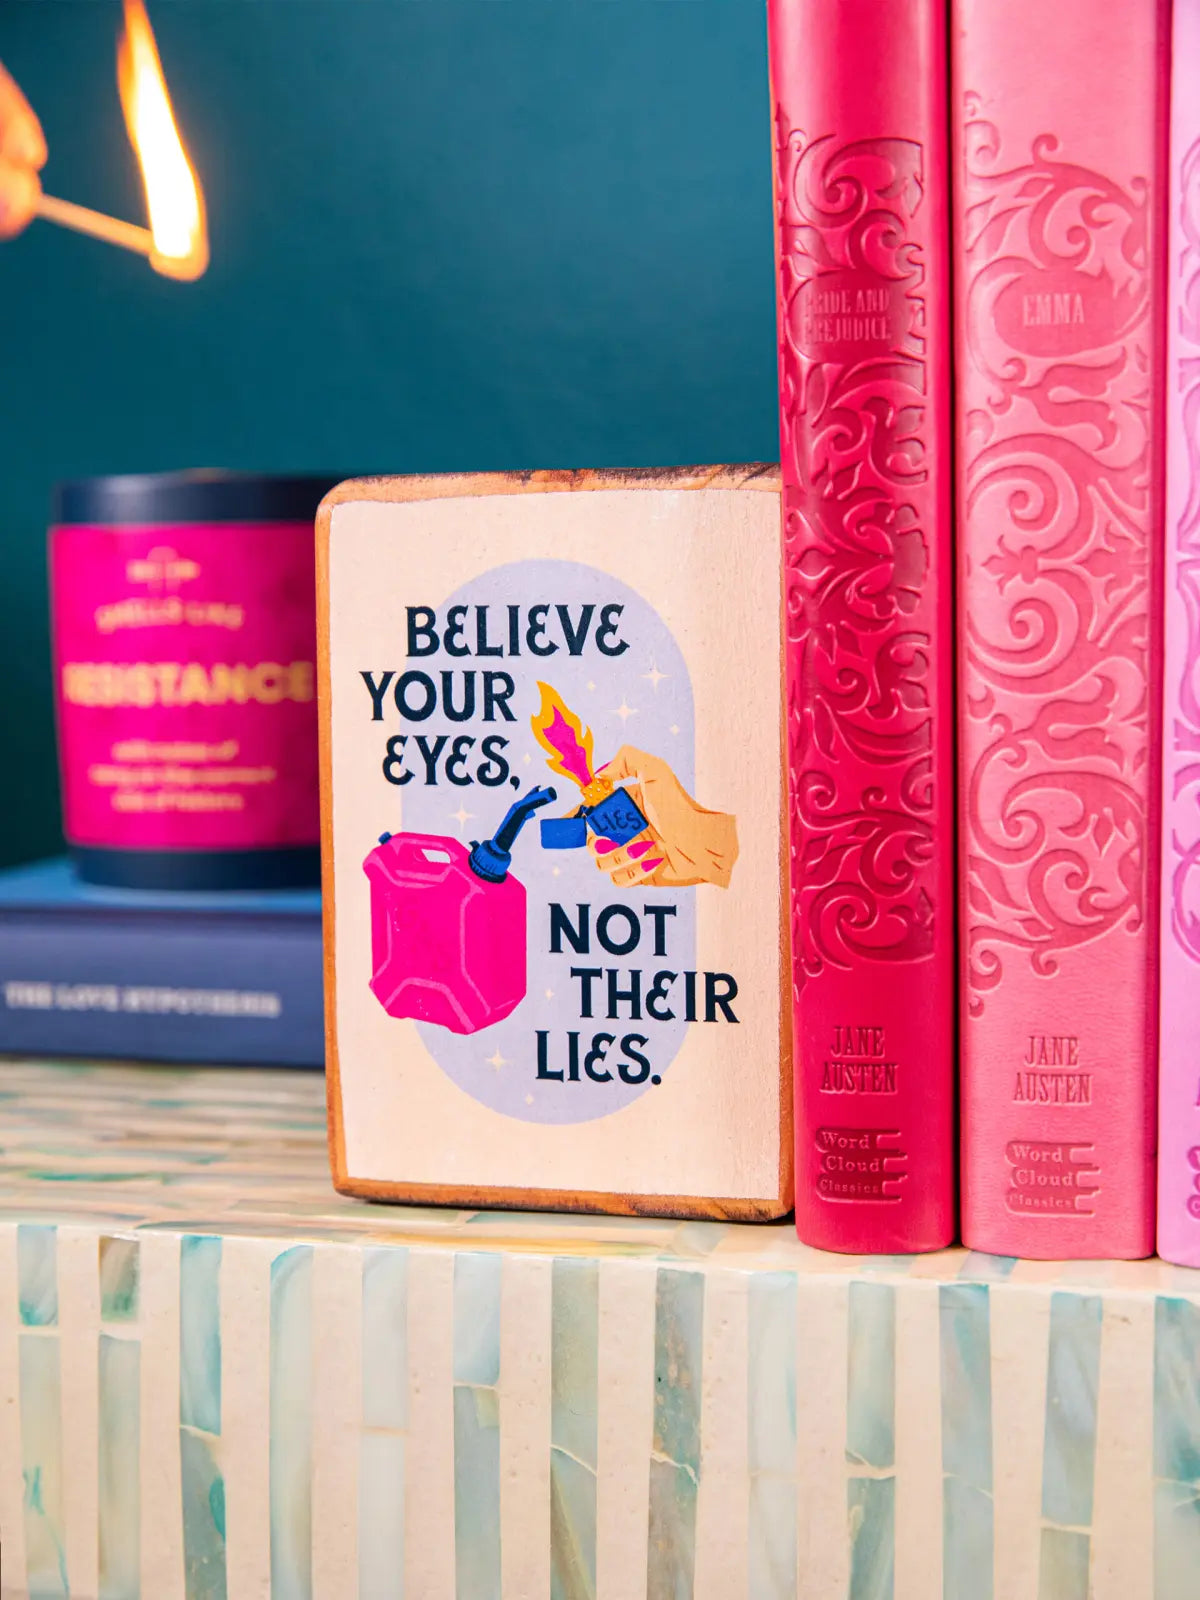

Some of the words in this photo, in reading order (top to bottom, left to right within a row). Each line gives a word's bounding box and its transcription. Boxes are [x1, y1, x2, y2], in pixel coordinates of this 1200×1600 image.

[855, 288, 890, 313] AND
[1023, 292, 1085, 326] EMMA
[804, 317, 892, 343] PREJUDICE
[405, 604, 630, 658] BELIEVE
[359, 670, 518, 722] YOUR
[382, 735, 521, 790] EYES,
[590, 809, 643, 833] LIES
[548, 903, 677, 956] NOT
[570, 966, 740, 1024] THEIR
[535, 1030, 662, 1085] LIES.
[830, 1026, 886, 1059] JANE
[1024, 1036, 1080, 1068] JANE
[819, 1063, 898, 1095] AUSTEN
[1012, 1072, 1093, 1105] AUSTEN
[821, 1131, 870, 1149] Word
[1012, 1145, 1064, 1163] Word
[826, 1155, 881, 1173] Cloud
[1015, 1169, 1074, 1187] Cloud
[820, 1179, 880, 1194] Classics
